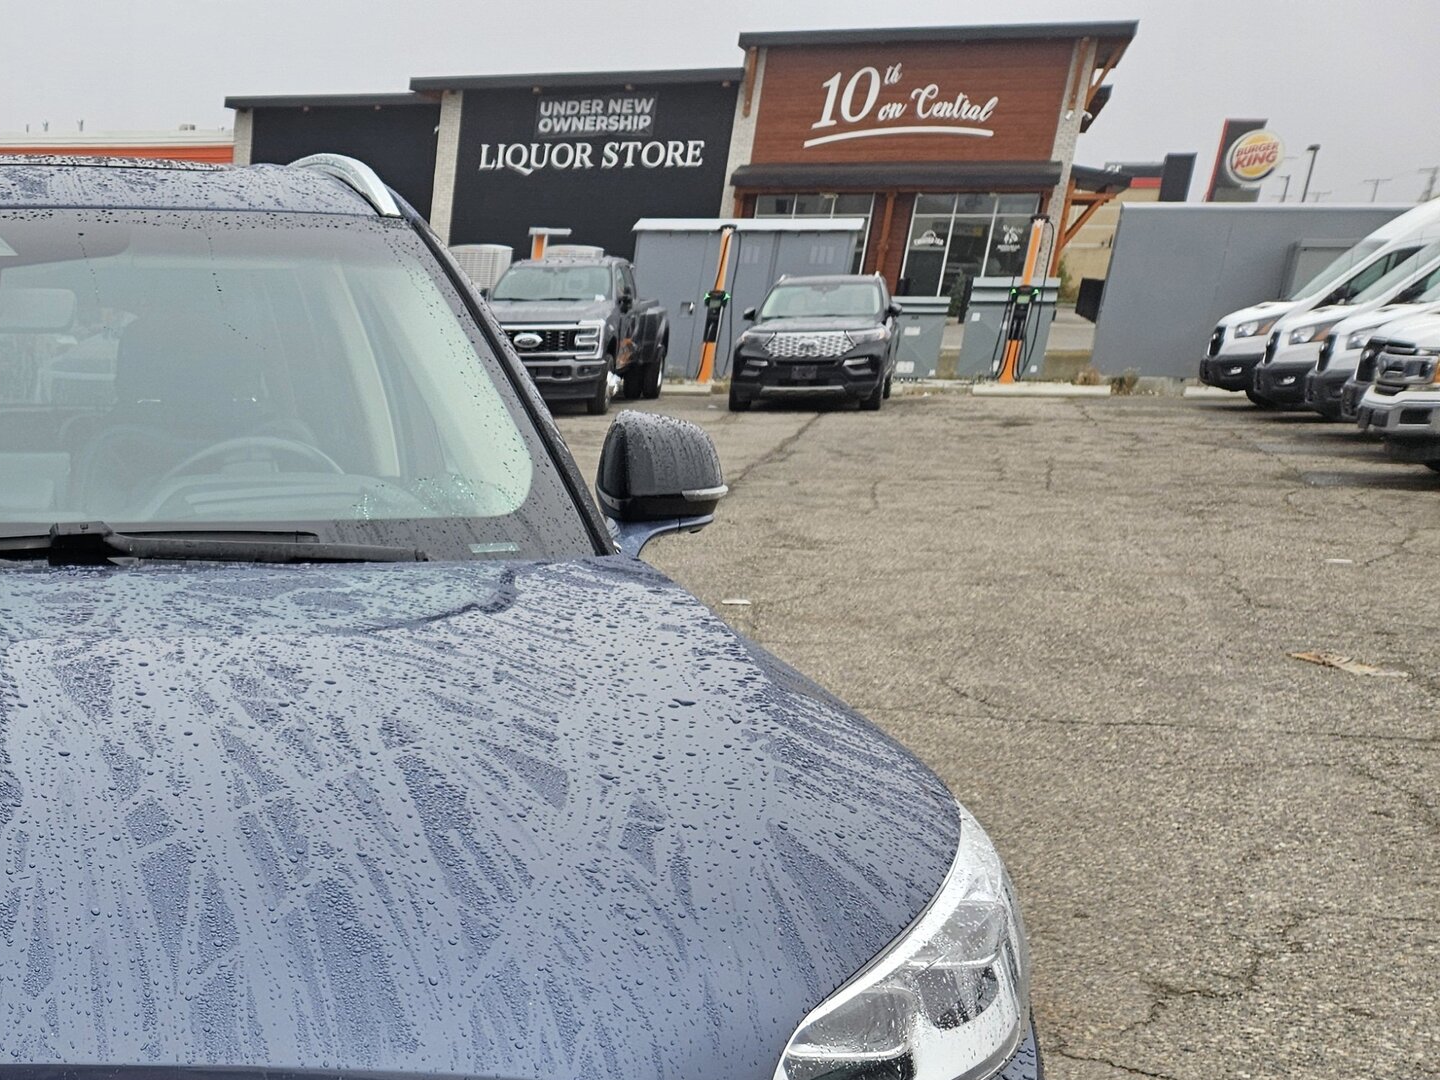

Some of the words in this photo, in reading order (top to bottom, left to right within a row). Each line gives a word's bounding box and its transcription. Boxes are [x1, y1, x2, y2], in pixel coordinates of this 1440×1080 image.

[540, 101, 603, 117] UNDER
[607, 98, 654, 115] NEW
[877, 102, 907, 121] on
[911, 84, 999, 122] Central
[538, 115, 652, 133] OWNERSHIP
[479, 142, 594, 175] LIQUOR
[601, 140, 705, 168] STORE
[1236, 141, 1279, 157] BURGER
[1234, 150, 1278, 170] KING
